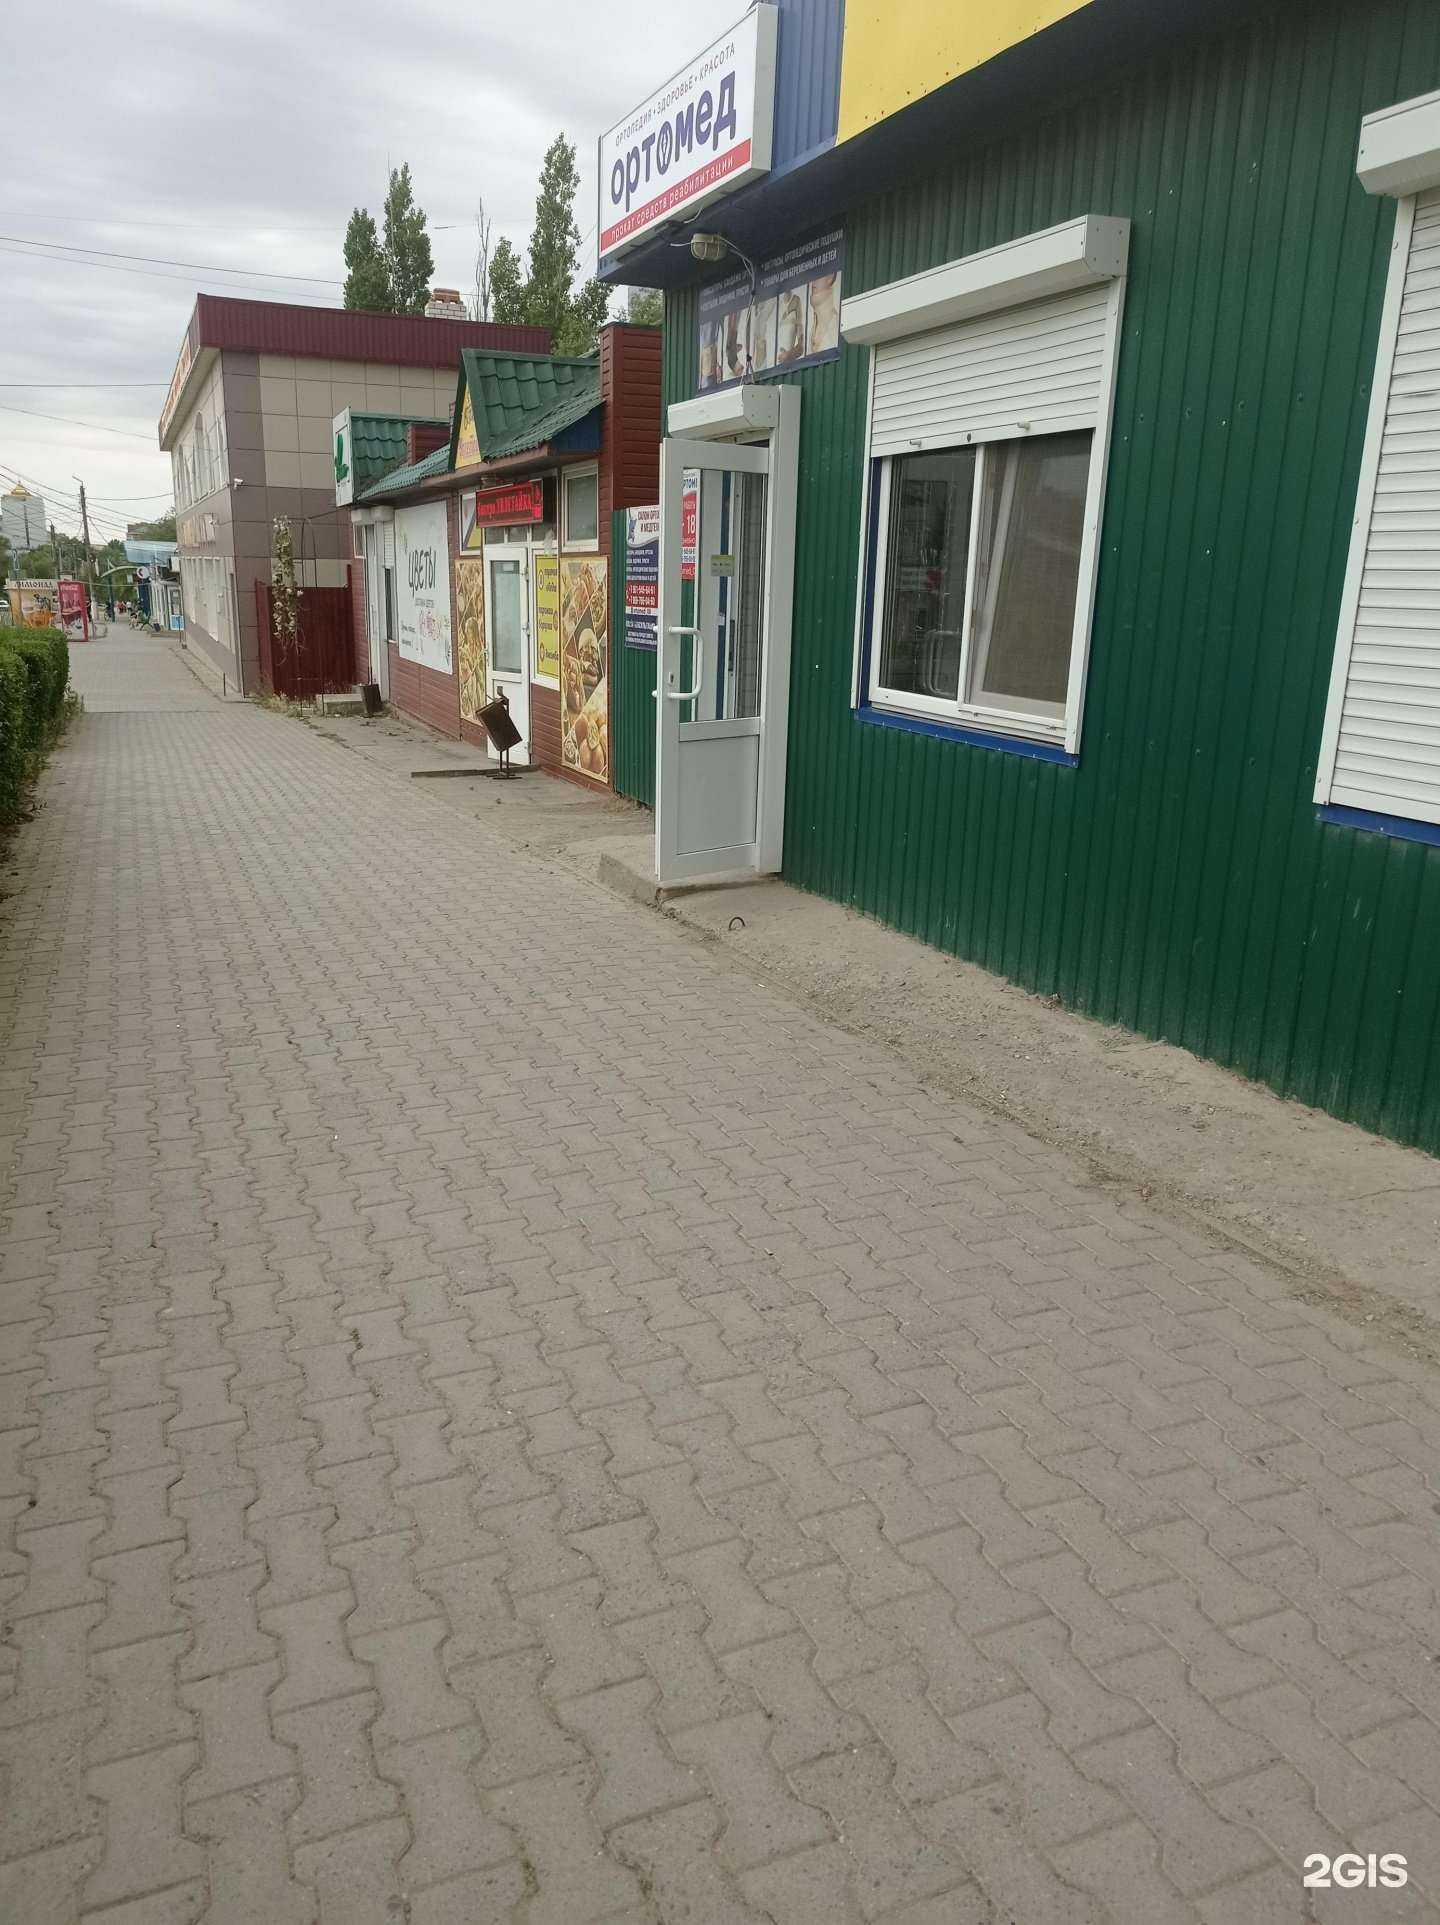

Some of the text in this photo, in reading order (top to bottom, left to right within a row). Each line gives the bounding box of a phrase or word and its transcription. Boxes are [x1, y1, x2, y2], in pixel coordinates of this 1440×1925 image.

[616, 42, 735, 147] ОРТОПЕДИЯ ЗДОРОВЬЕ КРАСОТА
[611, 219, 635, 241] прокат
[669, 156, 734, 209] реабилитации
[822, 248, 837, 265] ДЕТЕЙ
[408, 545, 437, 598] ЦВЕТЫ
